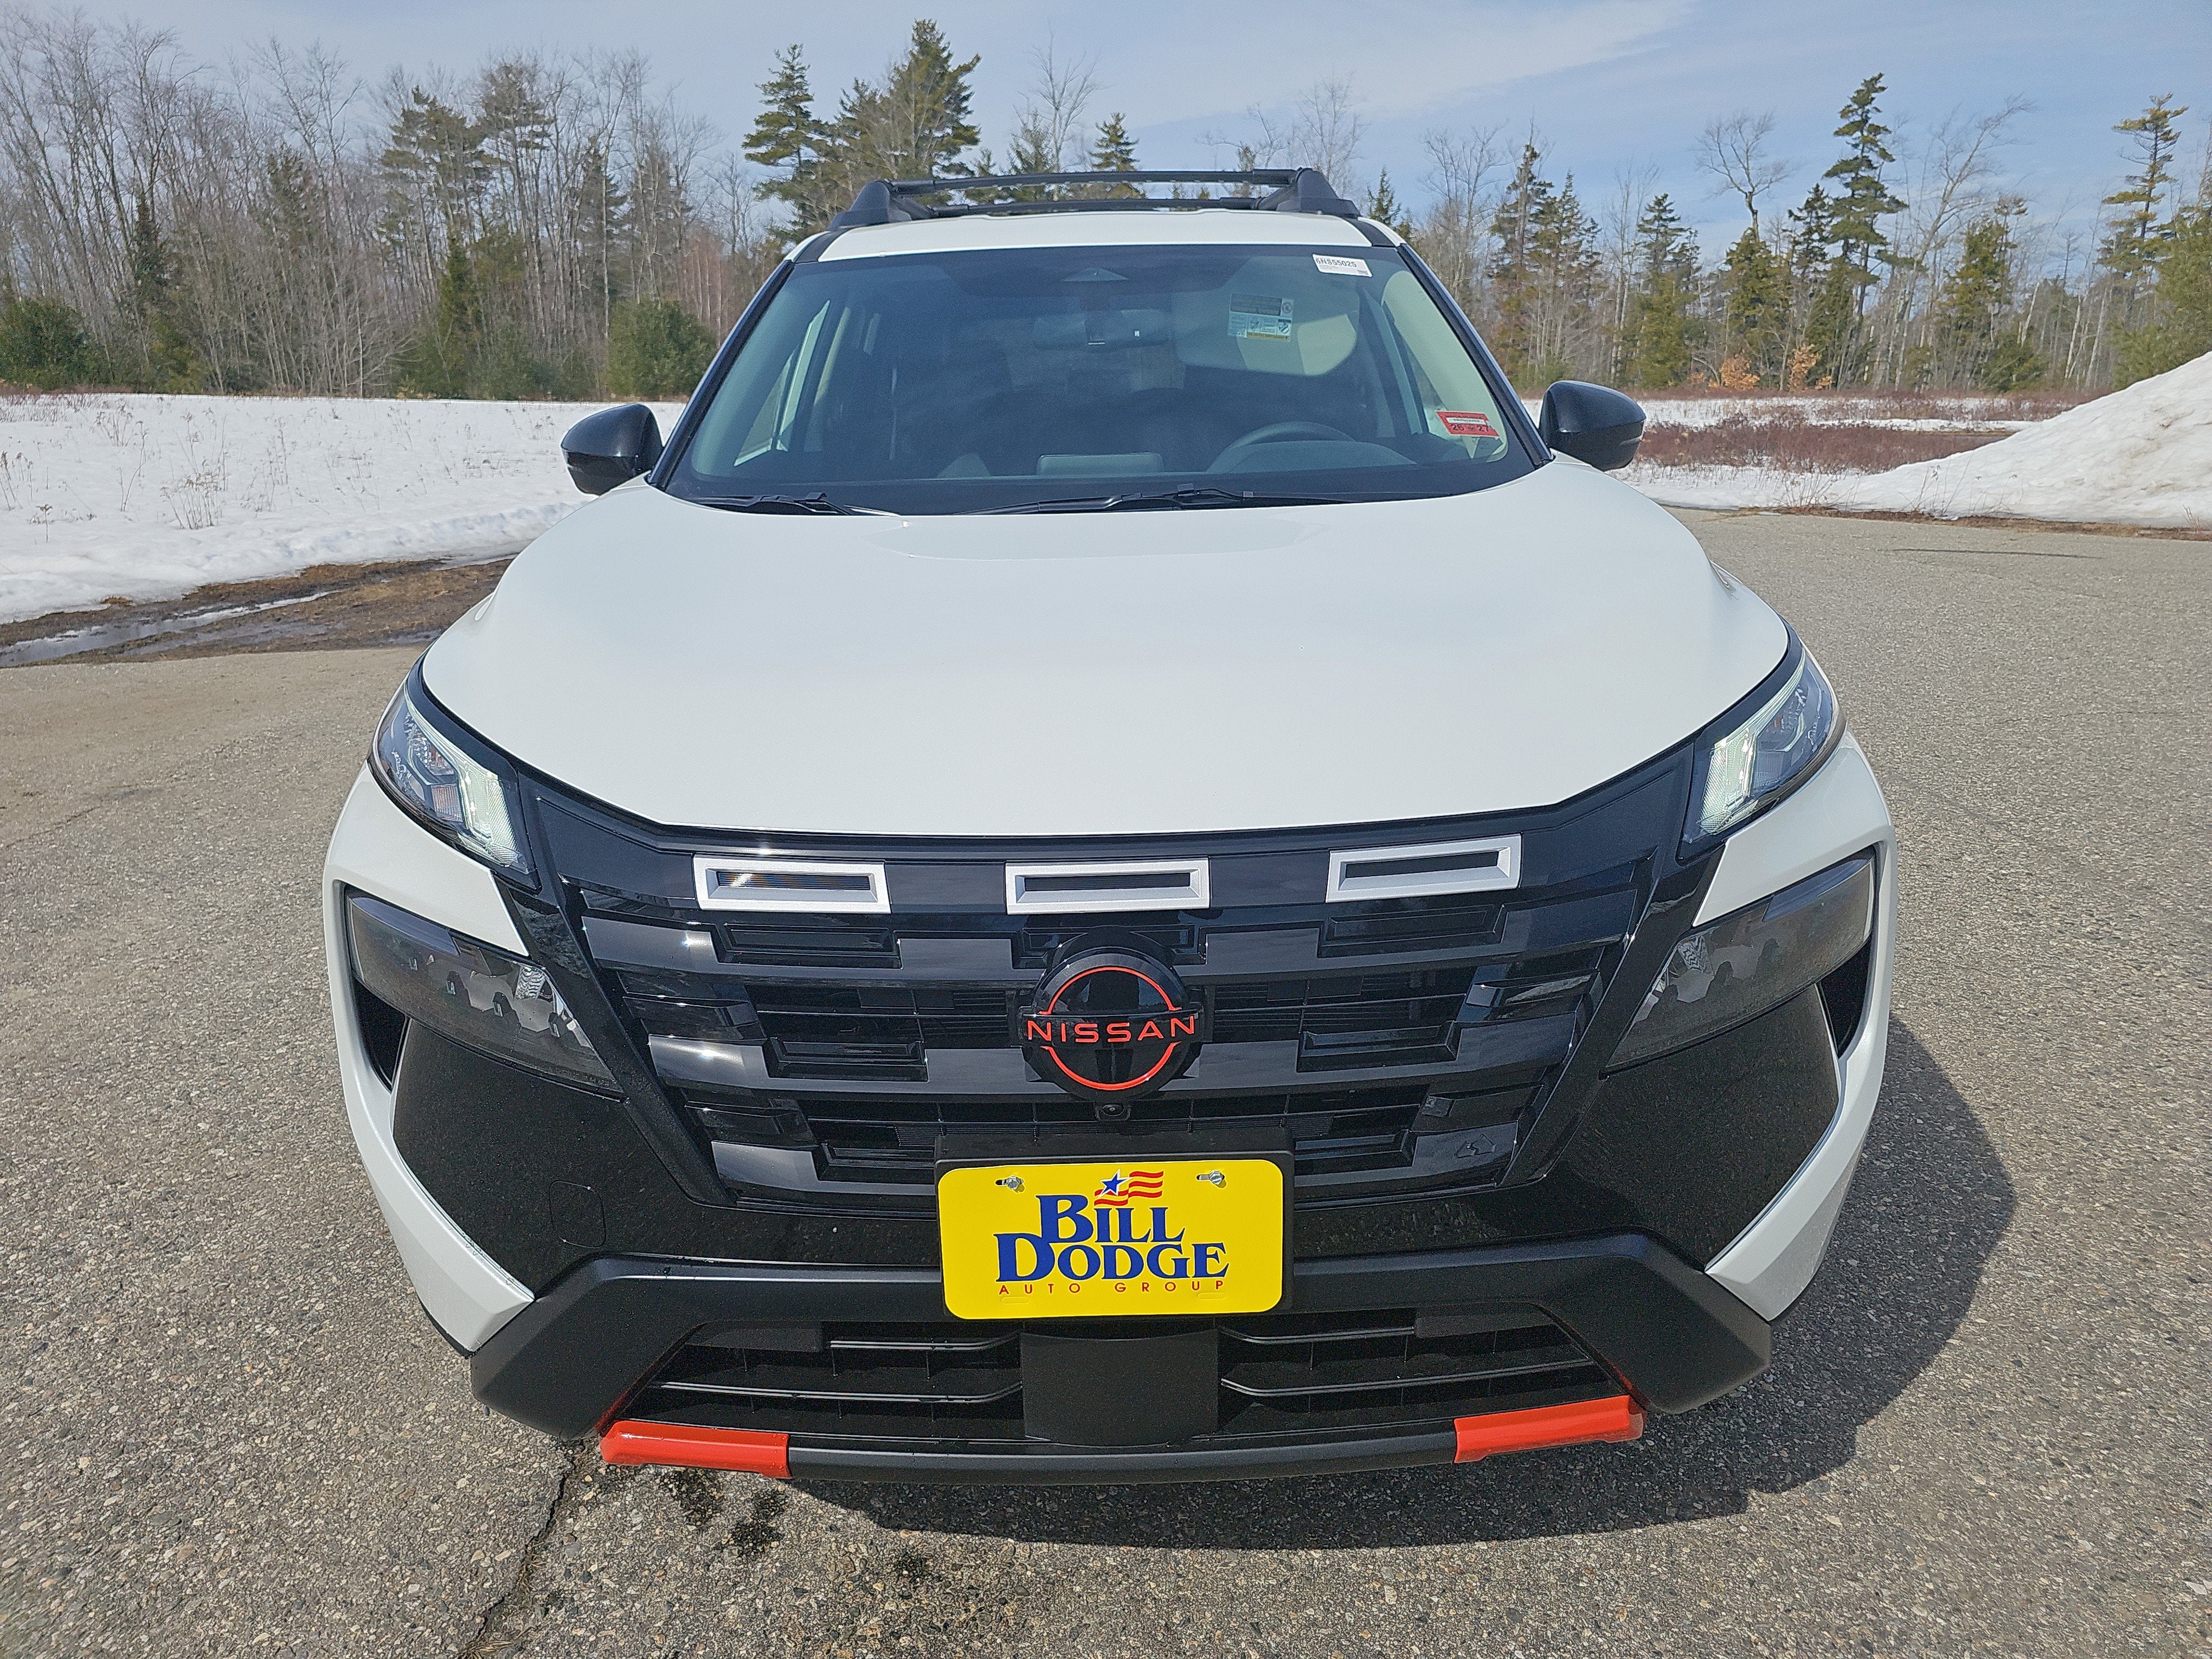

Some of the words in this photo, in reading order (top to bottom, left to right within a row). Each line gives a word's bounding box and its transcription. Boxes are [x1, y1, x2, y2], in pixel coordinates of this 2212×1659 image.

[1027, 1015, 1194, 1043] NISSAN
[1036, 1194, 1185, 1244] BILL
[993, 1232, 1229, 1282] DODGE
[999, 1282, 1081, 1295] AUTO
[1114, 1280, 1224, 1293] GROUP
